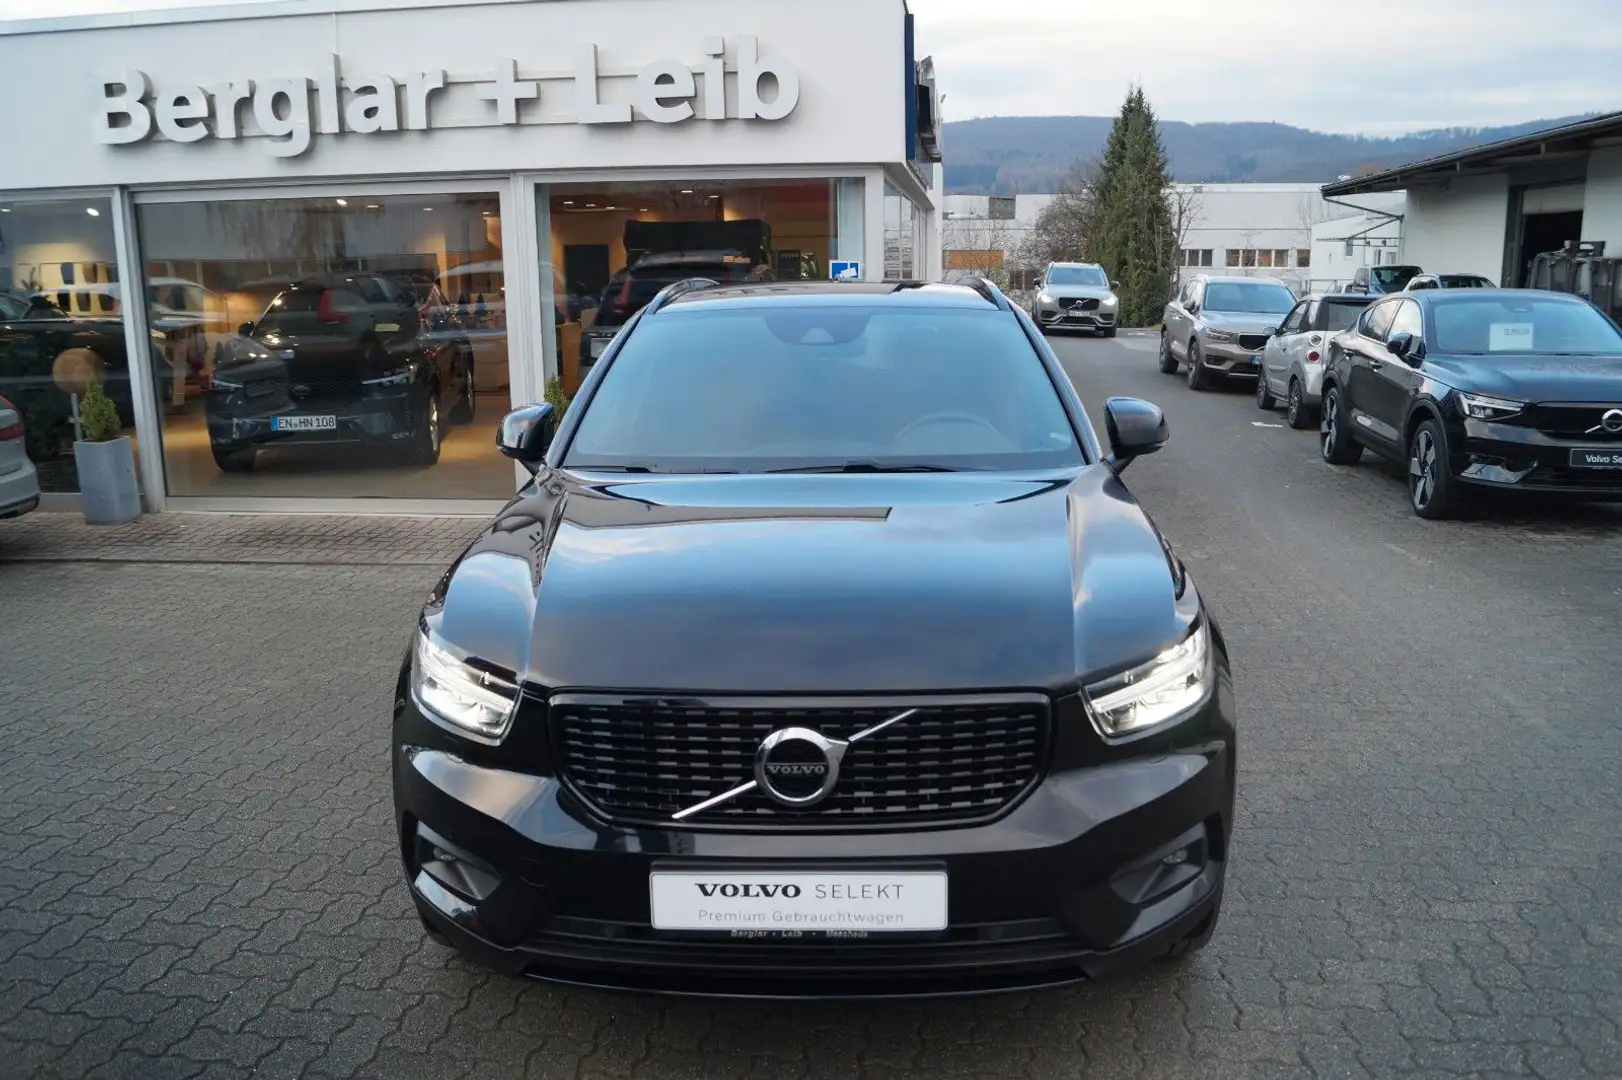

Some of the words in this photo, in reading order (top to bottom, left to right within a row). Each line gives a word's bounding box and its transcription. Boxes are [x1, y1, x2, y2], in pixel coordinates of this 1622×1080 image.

[95, 53, 447, 158] Berglar
[475, 58, 540, 124] +
[573, 33, 800, 124] Leib
[279, 418, 292, 429] EN
[300, 417, 313, 428] HN
[314, 416, 335, 428] 108
[1585, 454, 1610, 463] Volvo
[766, 765, 825, 774] VOLVO
[694, 883, 801, 898] VOLVO
[815, 884, 904, 899] SELEKT
[698, 910, 766, 922] Premium
[772, 910, 904, 925] Gebrauchtwagen
